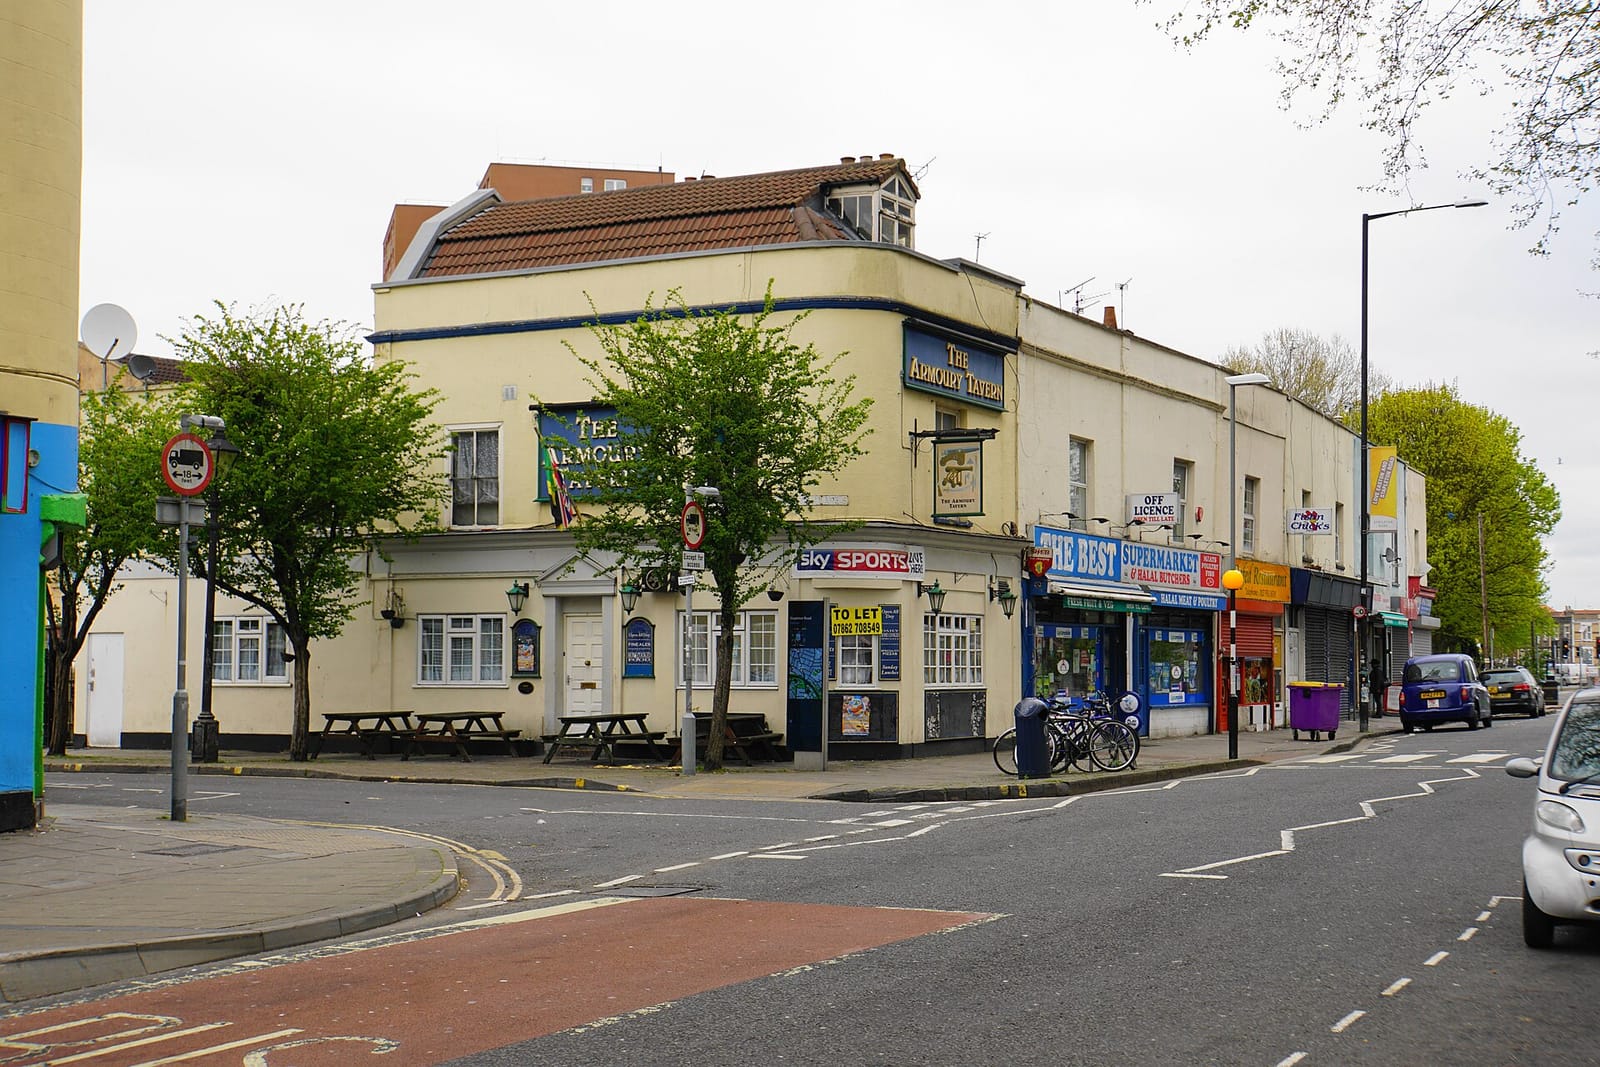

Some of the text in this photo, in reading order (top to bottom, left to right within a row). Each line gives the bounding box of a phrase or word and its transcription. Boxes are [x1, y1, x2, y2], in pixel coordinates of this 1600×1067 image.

[946, 342, 968, 370] THE
[909, 356, 1002, 401] ARMOURY TAVERN
[1144, 496, 1164, 505] OFF
[1134, 506, 1174, 515] LICENCE
[800, 550, 907, 569] sky SPORTS
[909, 552, 923, 563] LIVE
[1077, 538, 1117, 577] BEST
[1123, 544, 1198, 573] SUPERMARKET
[910, 564, 923, 573] HERE
[1131, 568, 1190, 585] & HALAL BUTCHERS
[1160, 593, 1178, 605] HALAL
[1178, 595, 1192, 605] MEAT
[1198, 597, 1217, 608] POULTRY
[833, 608, 878, 620] TO LET
[833, 623, 880, 634] 07862 708549
